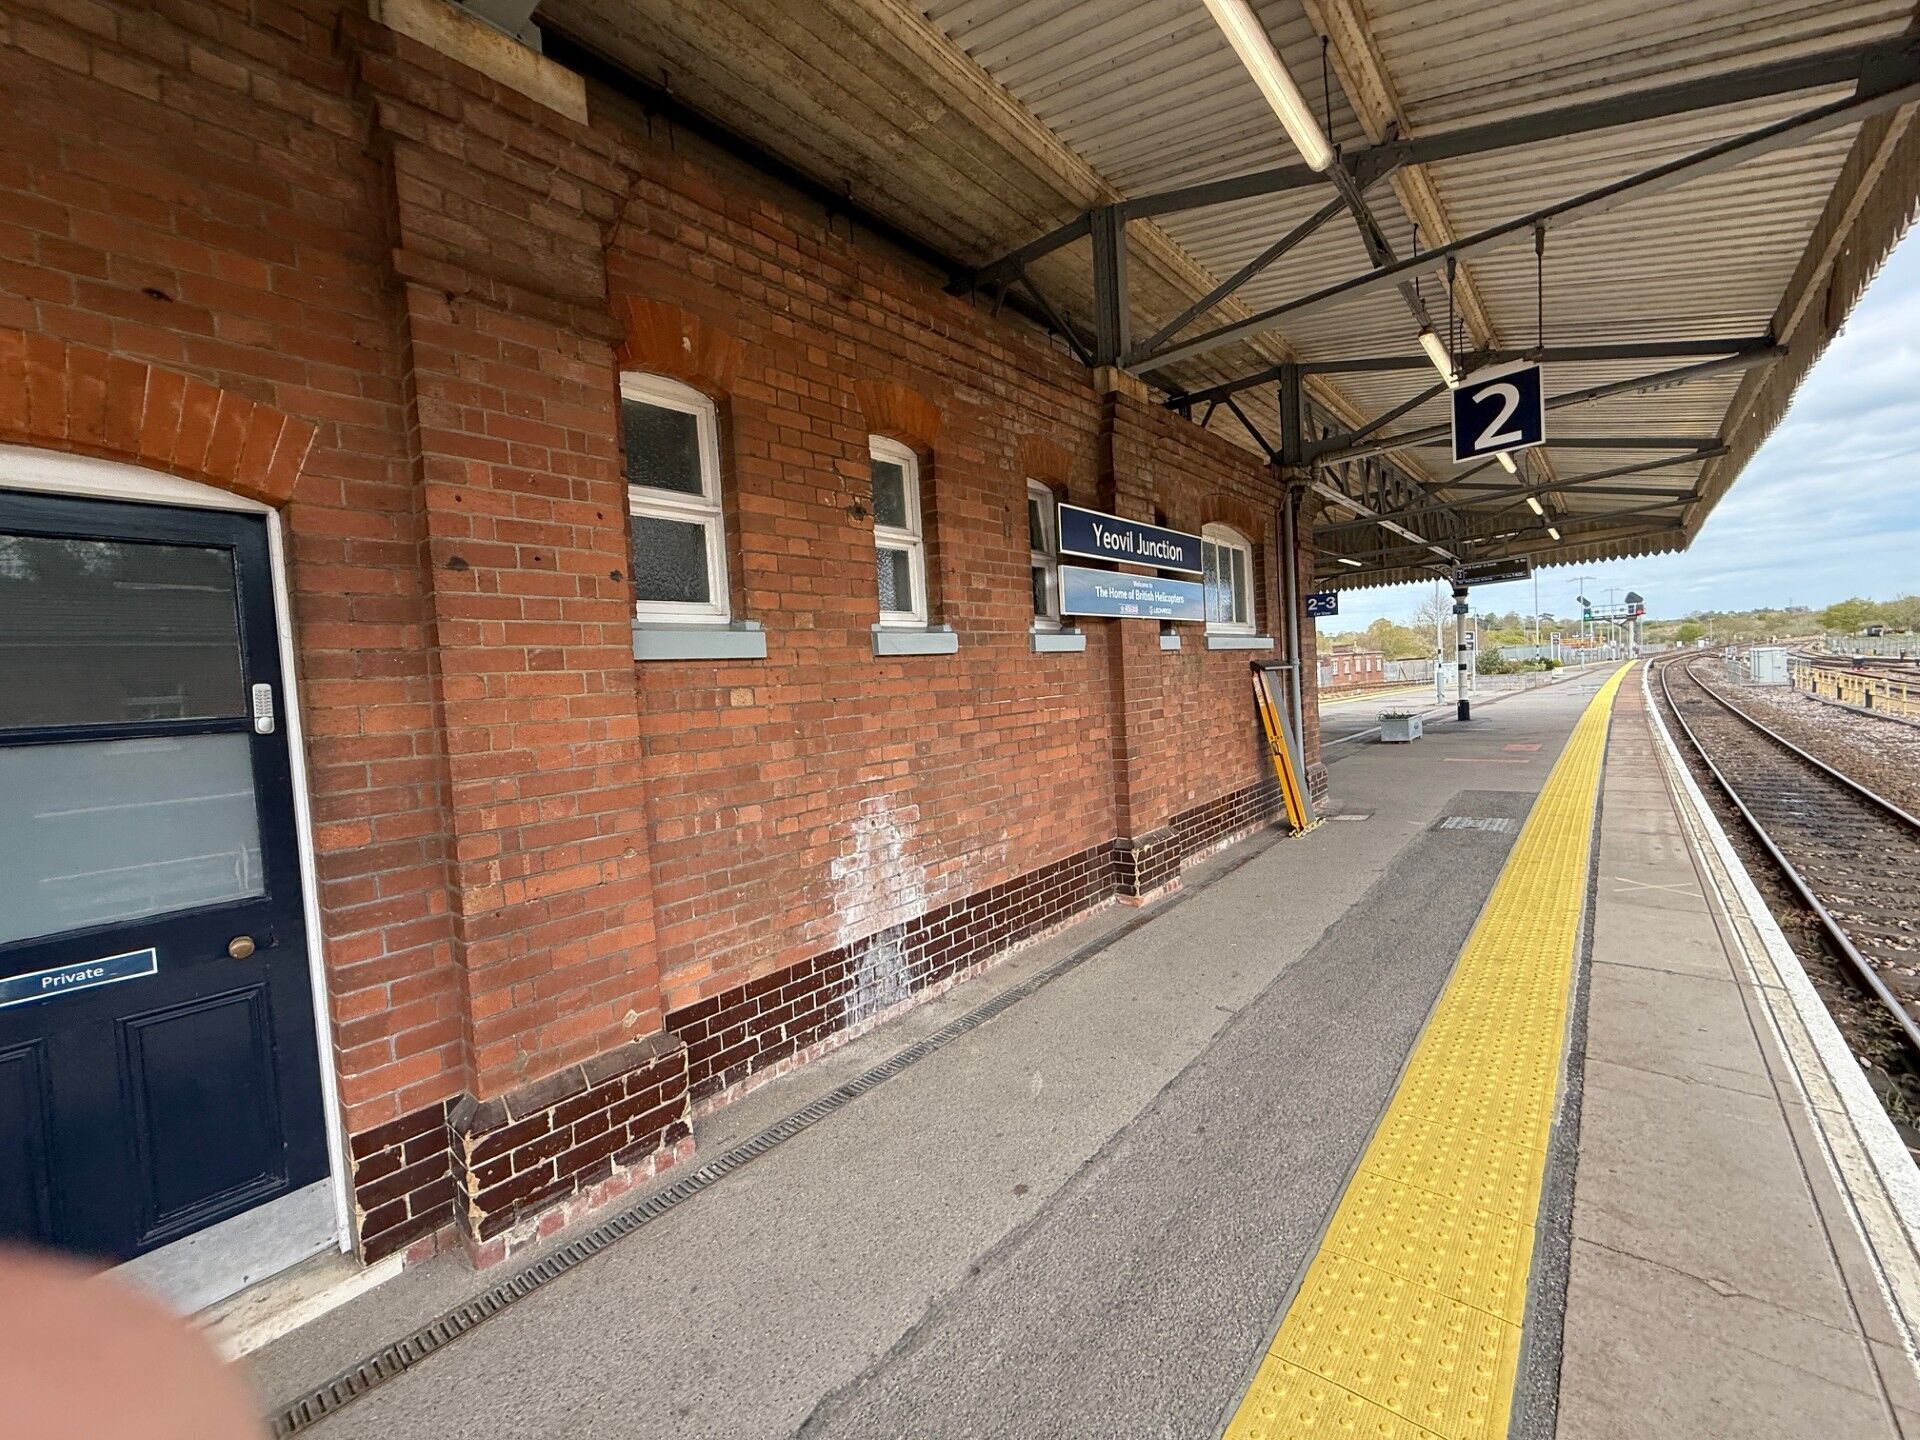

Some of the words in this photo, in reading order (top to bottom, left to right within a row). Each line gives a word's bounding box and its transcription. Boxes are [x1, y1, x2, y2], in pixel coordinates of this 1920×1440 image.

[1472, 382, 1523, 451] 2
[1092, 522, 1134, 553] Yeovil
[1136, 532, 1183, 562] Junction
[1095, 586, 1108, 598] The
[1109, 587, 1128, 599] Home
[1128, 589, 1135, 600] of
[1135, 589, 1154, 601] British
[1155, 591, 1184, 604] Helicopters
[1308, 596, 1336, 611] 2-3
[41, 967, 104, 989] Private
